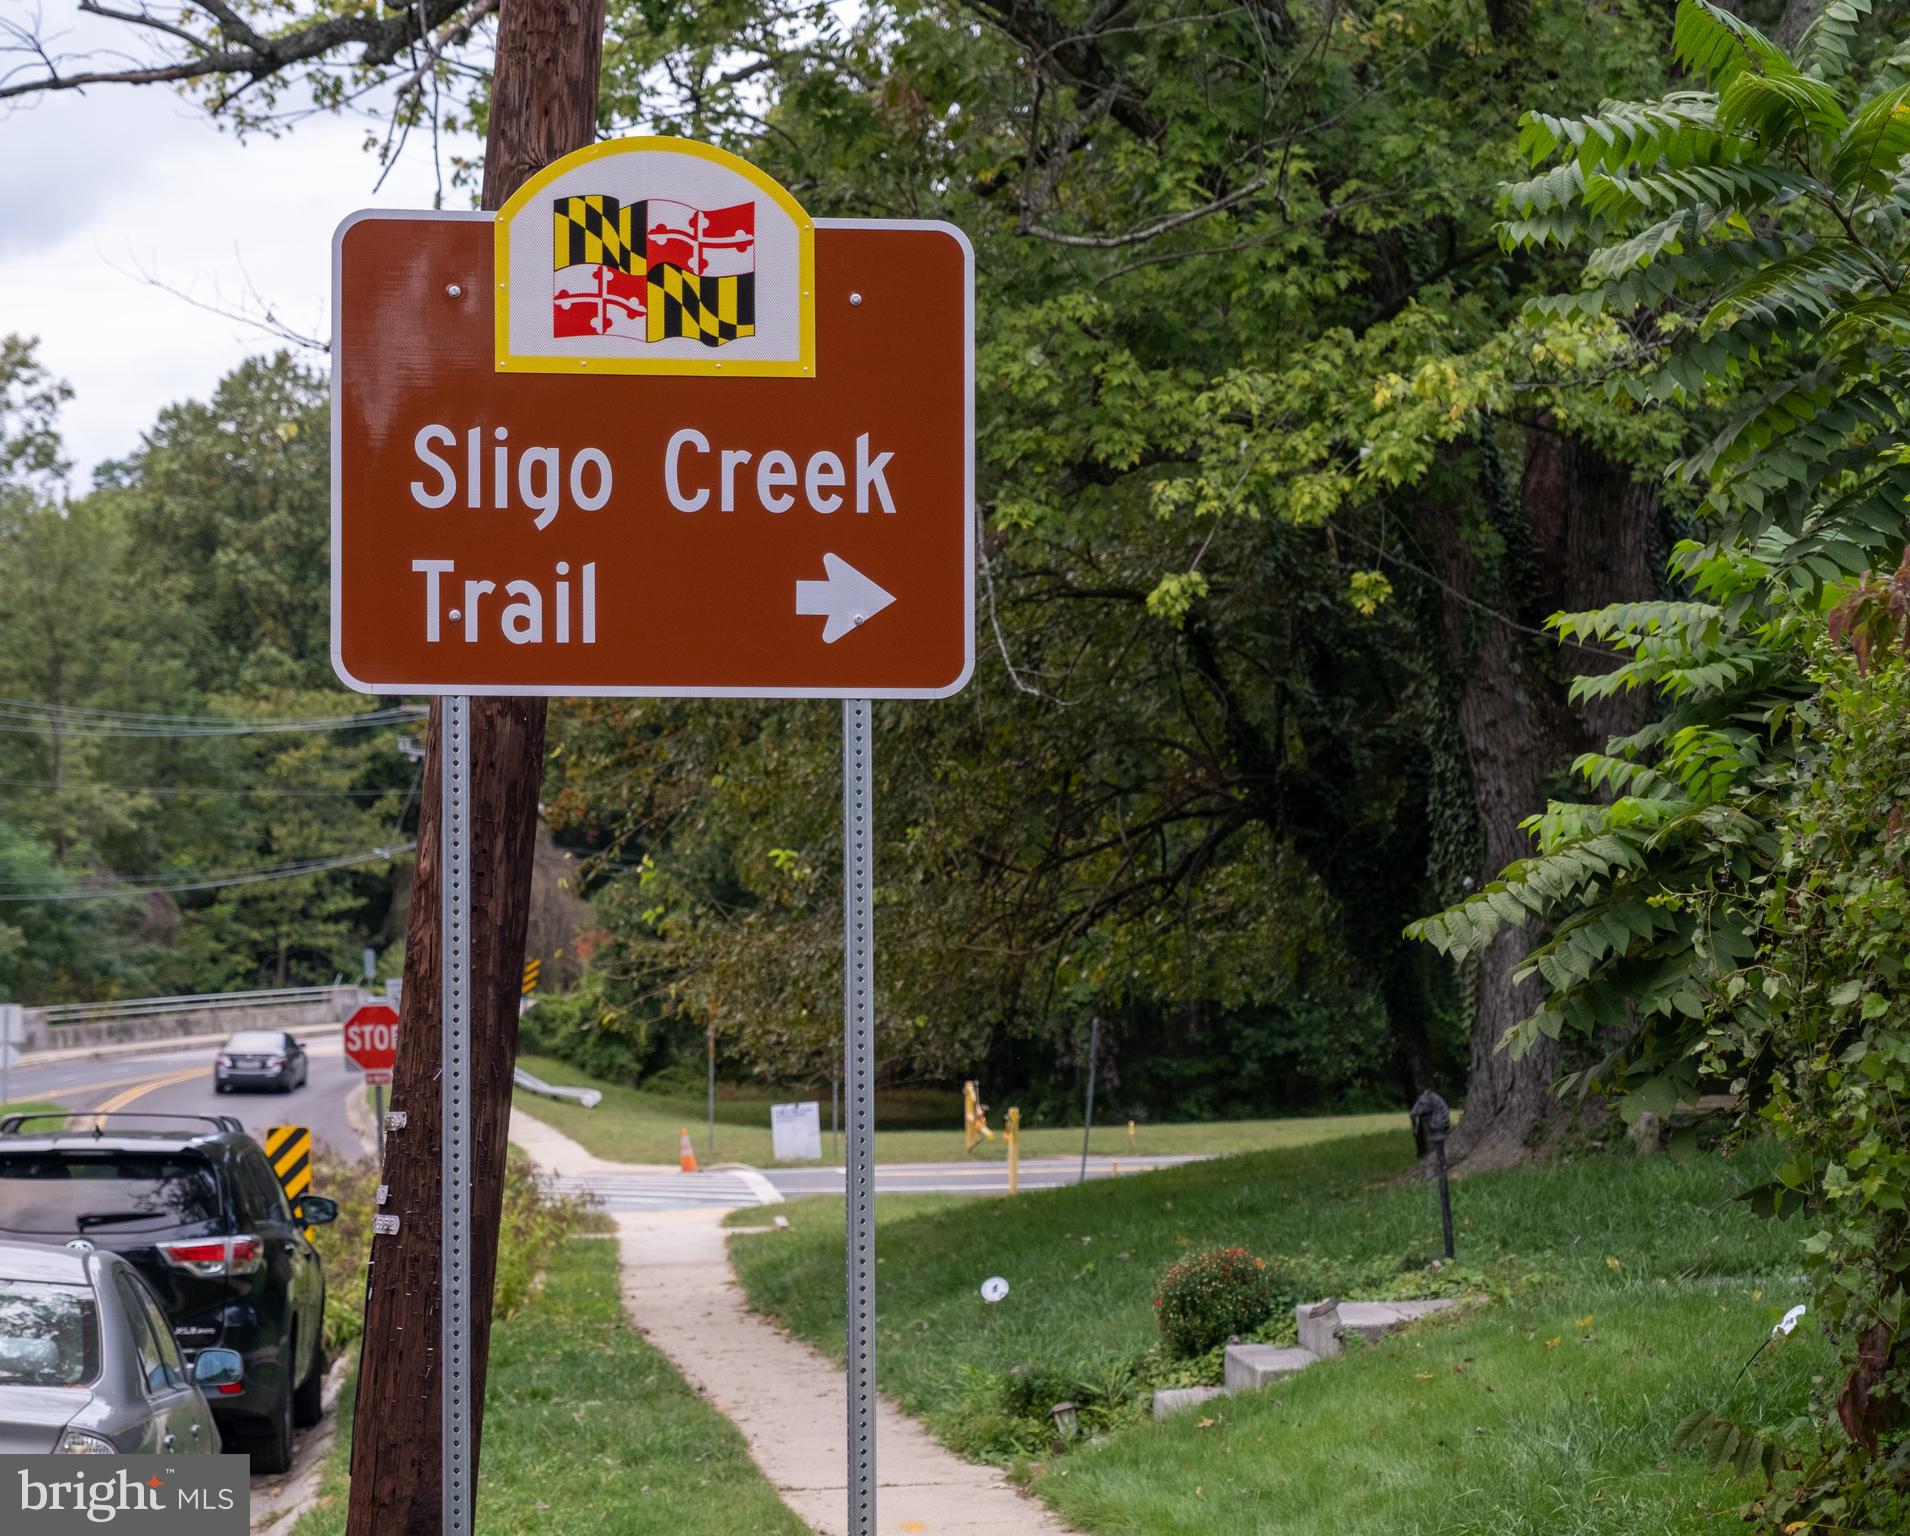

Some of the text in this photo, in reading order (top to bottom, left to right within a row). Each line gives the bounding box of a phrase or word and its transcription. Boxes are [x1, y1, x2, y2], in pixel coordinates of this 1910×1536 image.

[410, 424, 897, 530] Sligo Creek
[411, 559, 597, 644] Trail
